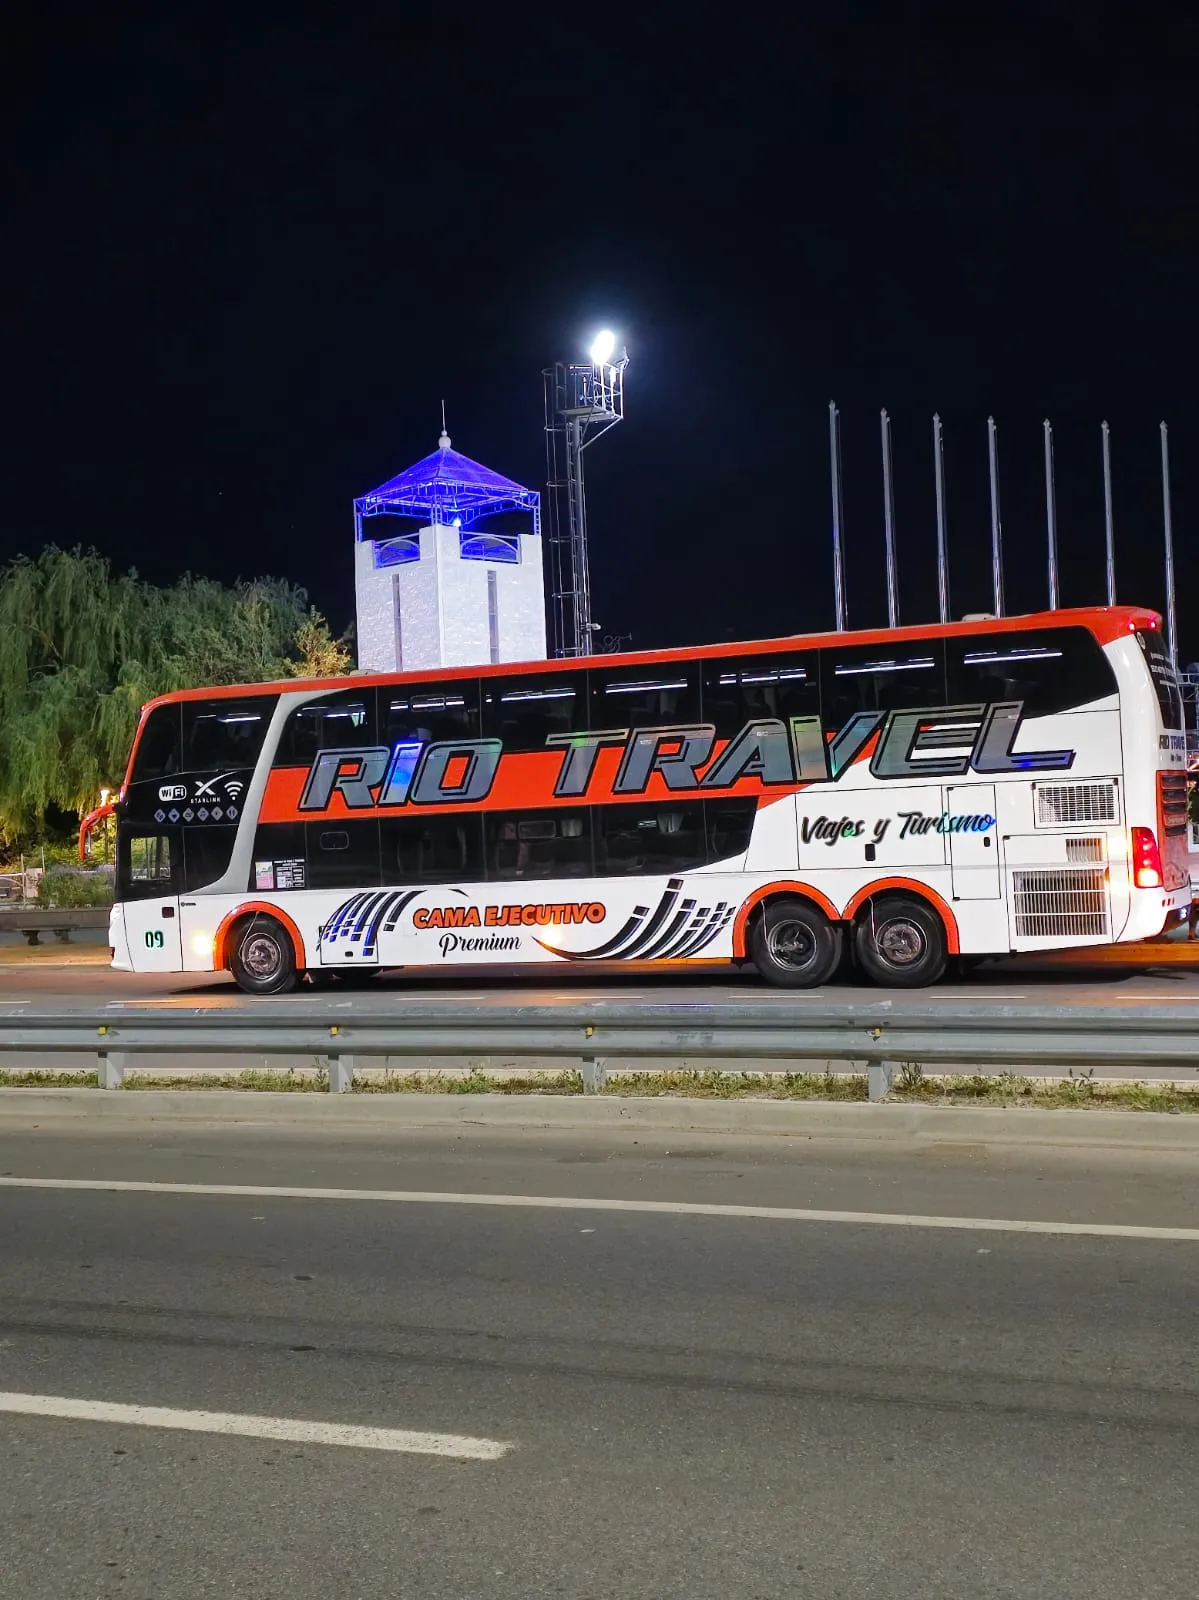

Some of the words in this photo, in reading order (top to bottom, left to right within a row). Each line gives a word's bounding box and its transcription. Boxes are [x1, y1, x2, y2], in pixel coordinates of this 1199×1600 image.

[298, 738, 503, 811] RIO
[544, 700, 1075, 798] TRAVEL
[802, 815, 866, 847] Viajes
[870, 817, 892, 845] y
[897, 811, 997, 840] Turismo
[413, 906, 481, 929] CAMA
[484, 902, 606, 927] EJECUTIVO
[144, 930, 164, 949] 09
[438, 931, 523, 958] Premium
